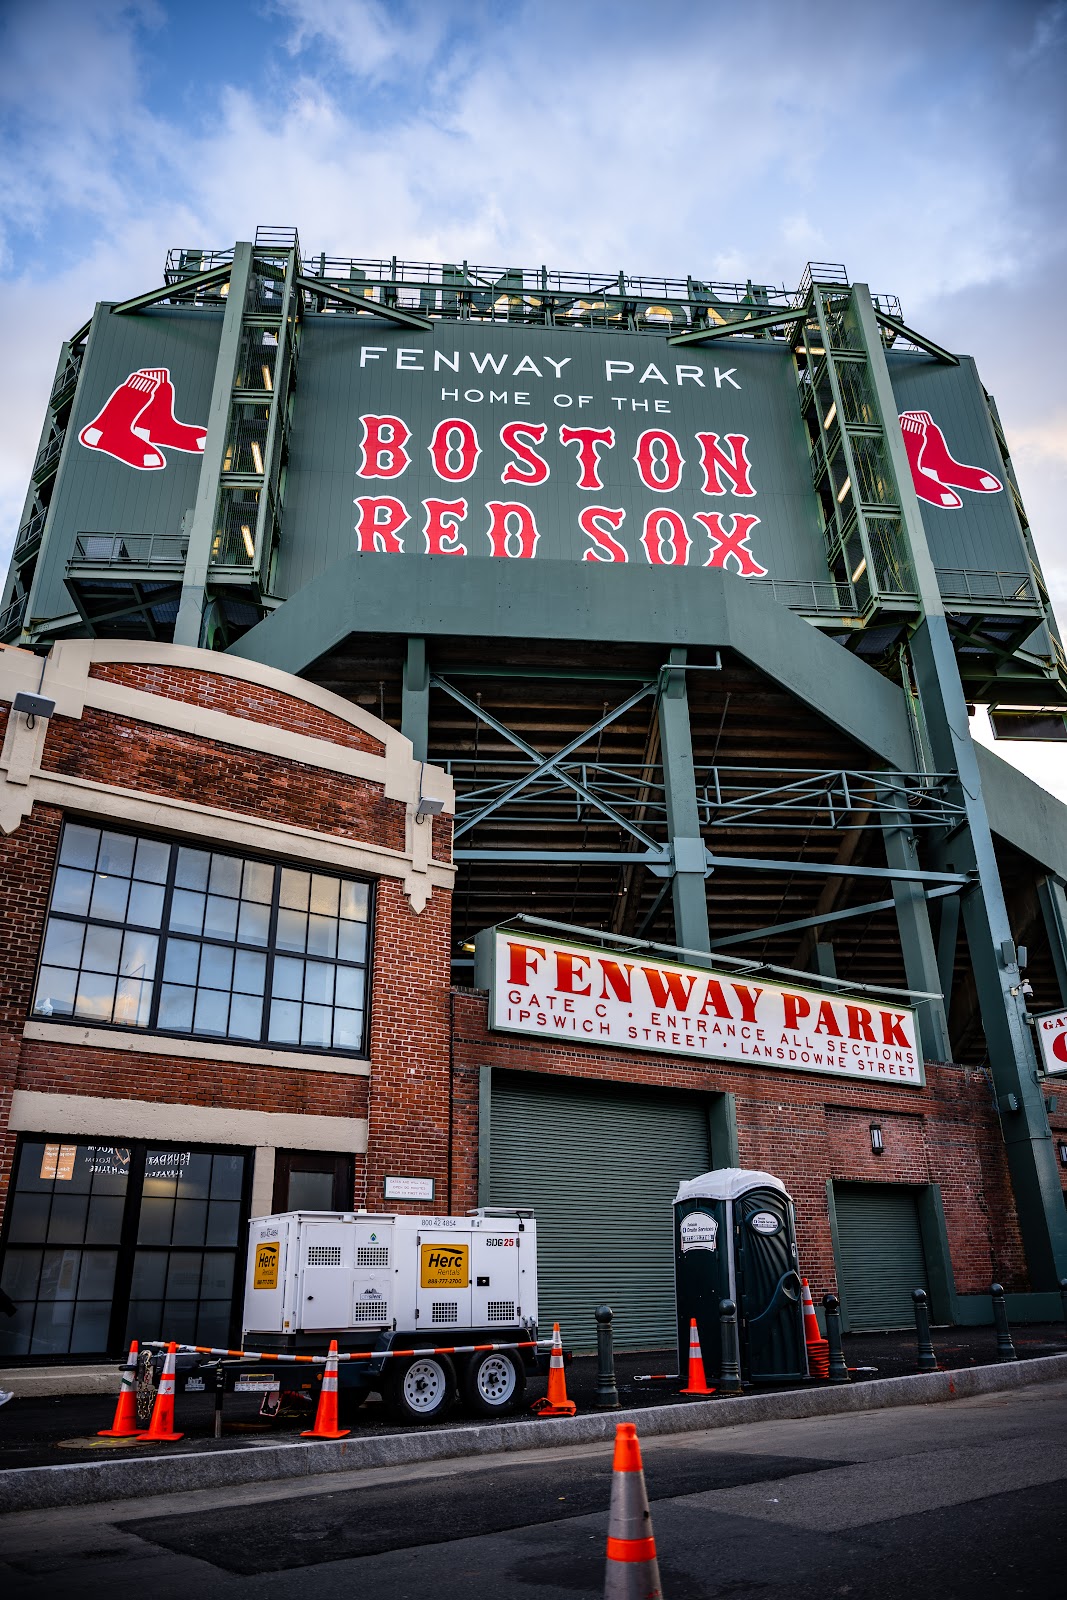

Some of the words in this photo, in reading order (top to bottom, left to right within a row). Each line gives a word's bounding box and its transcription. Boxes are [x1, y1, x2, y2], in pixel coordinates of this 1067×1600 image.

[360, 346, 573, 379] FENWAY
[605, 360, 742, 390] PARK
[441, 387, 531, 406] HOME
[553, 394, 594, 408] OF
[611, 397, 672, 414] THE
[355, 413, 758, 498] BOSTON
[353, 495, 542, 559] RED
[578, 505, 769, 578] SOX
[506, 941, 764, 1024] FENWAY
[782, 992, 913, 1049] PARK
[507, 990, 575, 1015] GATE
[595, 1003, 608, 1018] C
[651, 1012, 767, 1042] ENTRANCE
[780, 1033, 814, 1049] ALL
[827, 1039, 915, 1065] SECTIONS
[508, 1008, 611, 1036] IPSWICH
[628, 1026, 709, 1049] STREET
[740, 1042, 847, 1069] LANSDOWNE
[858, 1059, 916, 1078] STREET
[258, 1252, 277, 1268] Herc
[428, 1253, 463, 1268] Herc
[437, 1268, 461, 1276] Rentals
